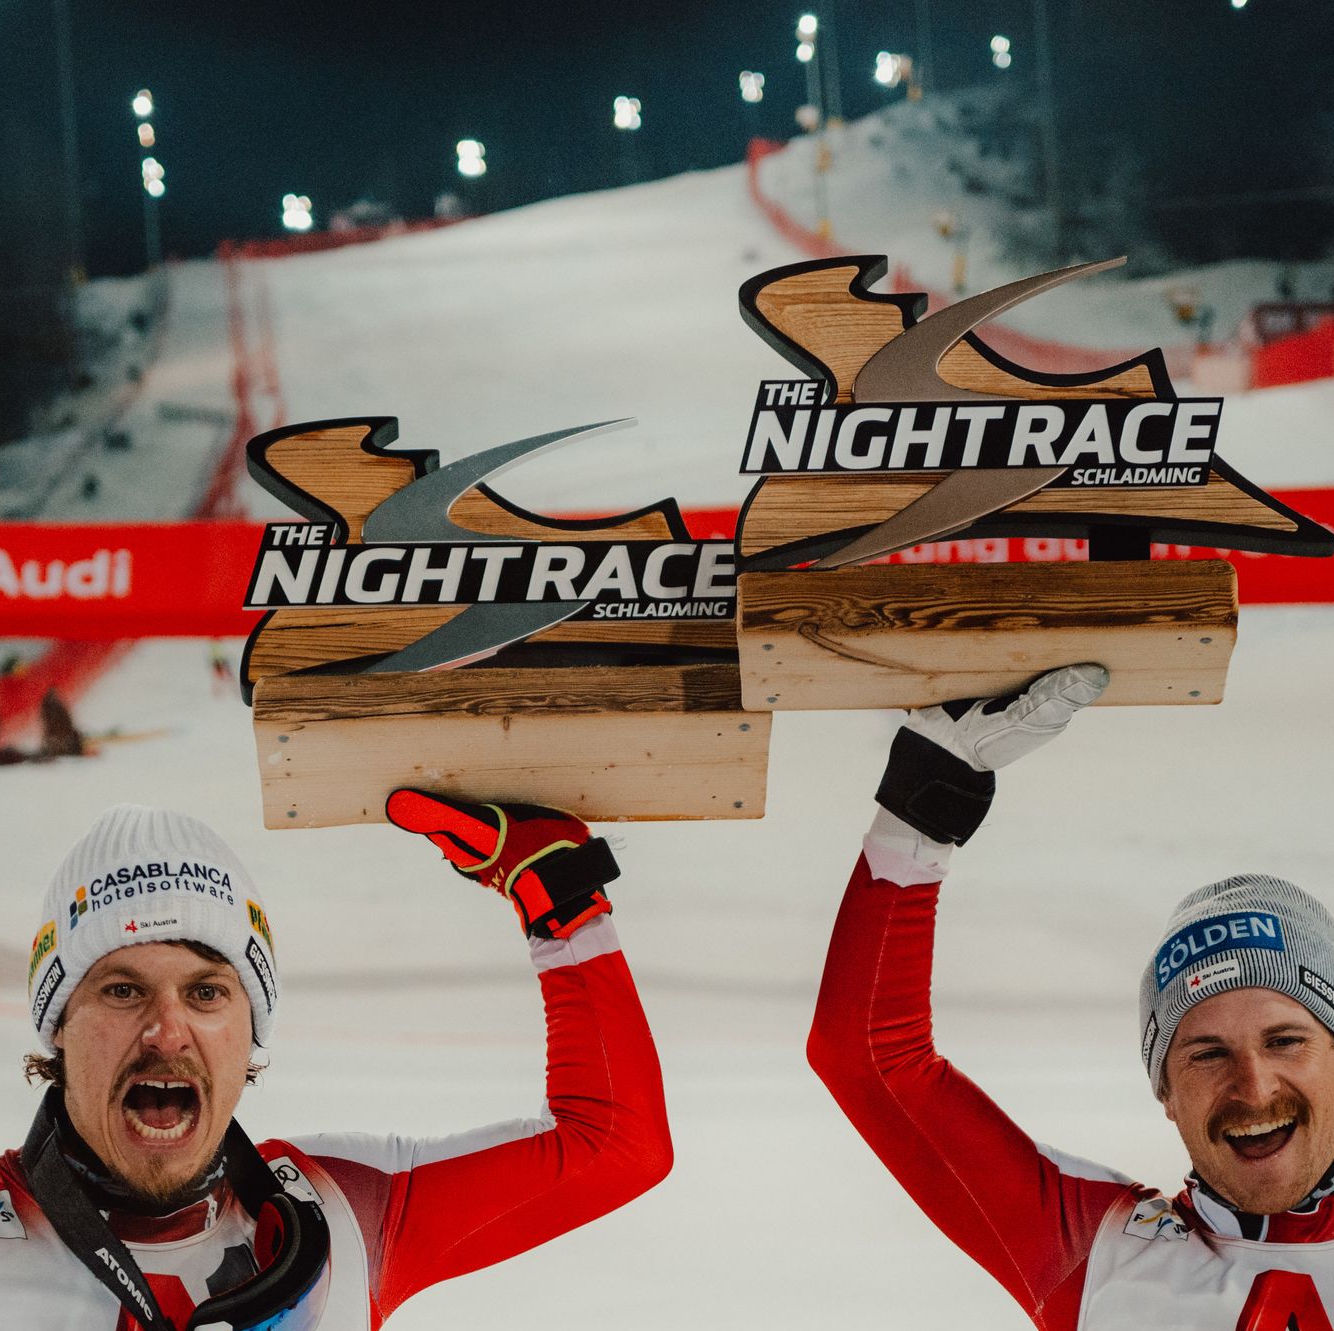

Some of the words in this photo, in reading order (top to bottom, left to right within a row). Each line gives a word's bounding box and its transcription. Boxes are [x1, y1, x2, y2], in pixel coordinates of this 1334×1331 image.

[765, 383, 818, 406] THE
[1071, 467, 1202, 486] SCHLADMING
[270, 525, 327, 546] THE
[592, 601, 728, 619] SCHLADMING
[90, 862, 232, 897] CASABLANCA
[91, 877, 235, 912] hotelsoftware
[140, 921, 151, 930] Ski
[153, 918, 178, 928] Austria
[1158, 916, 1276, 984] SÖLDEN
[1202, 973, 1212, 981] Ski
[1213, 966, 1235, 977] Austria
[94, 1247, 155, 1322] ATOMIC
